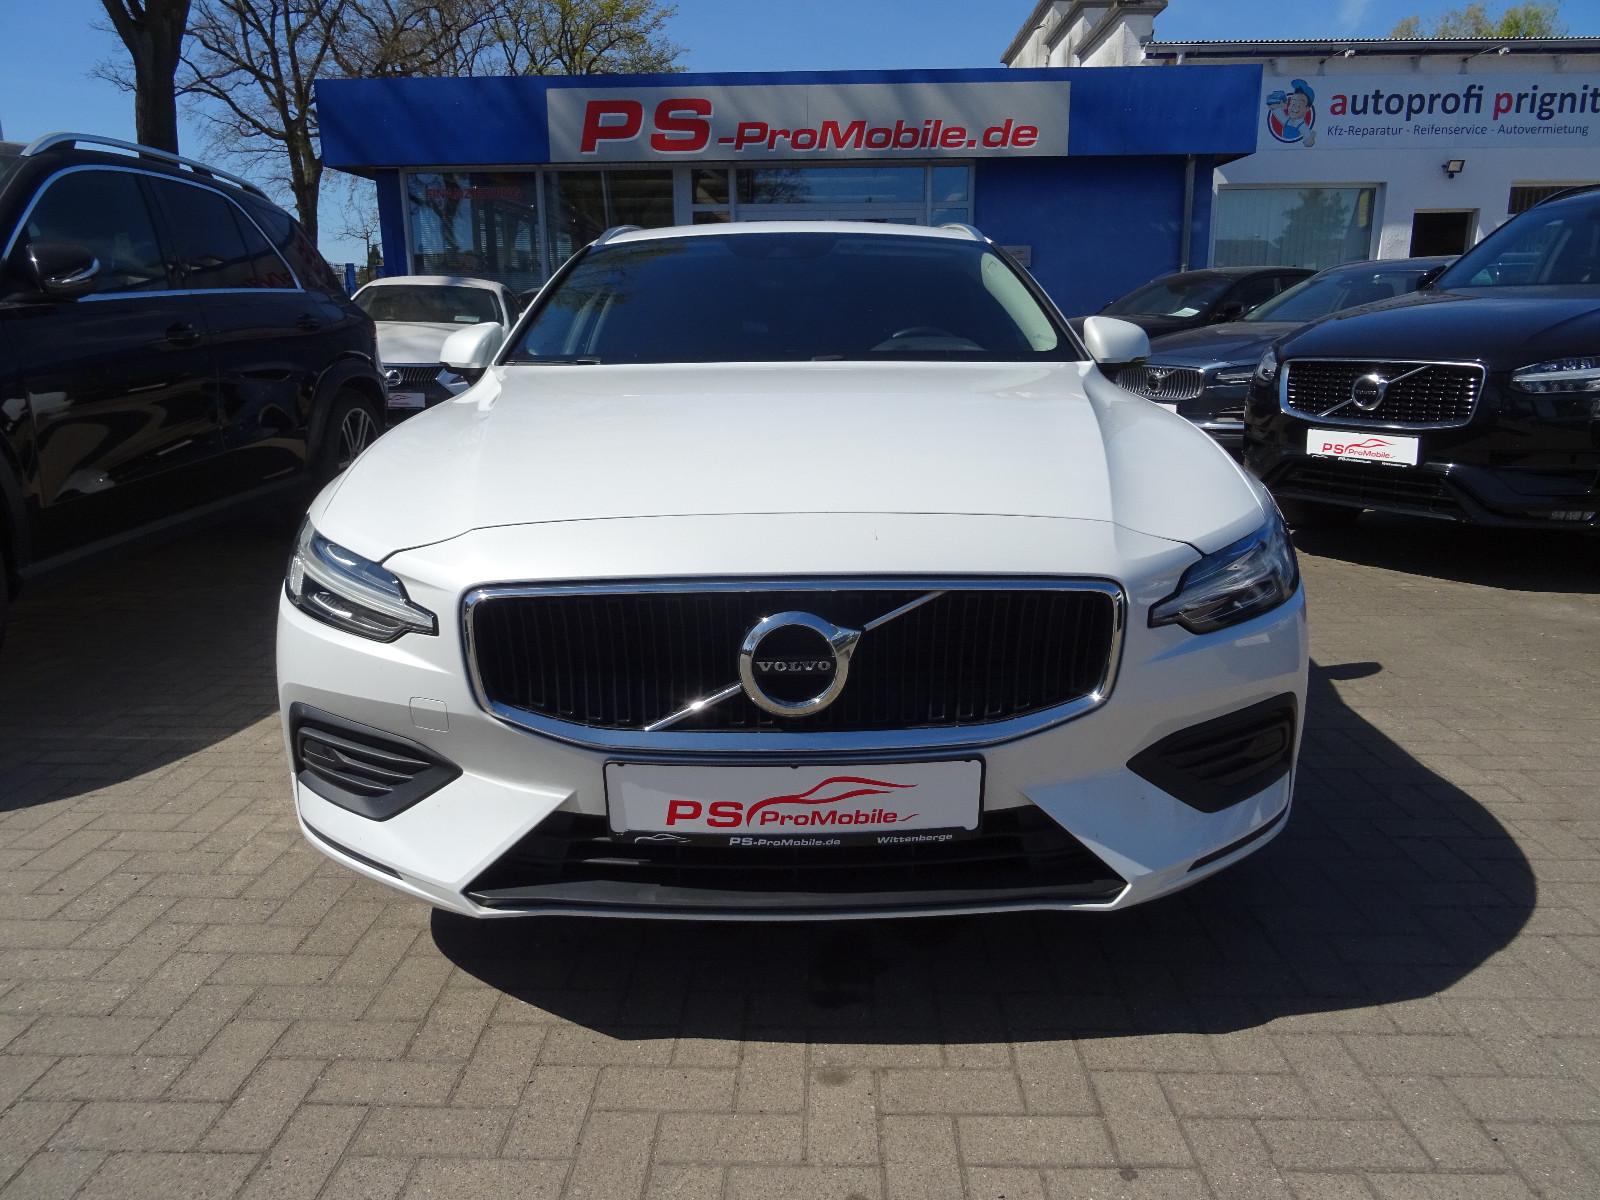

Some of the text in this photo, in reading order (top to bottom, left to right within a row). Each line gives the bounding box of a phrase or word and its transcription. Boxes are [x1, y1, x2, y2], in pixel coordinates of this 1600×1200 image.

[1329, 84, 1600, 121] autoprofi prignit
[580, 98, 1038, 153] PS-ProMobile.de
[1327, 125, 1403, 137] Kfz-Reparatur
[1413, 124, 1488, 136] Reifenservice
[1497, 123, 1590, 136] Autovermietung
[1322, 443, 1345, 454] PS
[756, 661, 831, 671] VOLVO
[665, 800, 898, 828] PS ProMobile
[729, 834, 953, 846] PS-ProMobile.de Wittenberge
